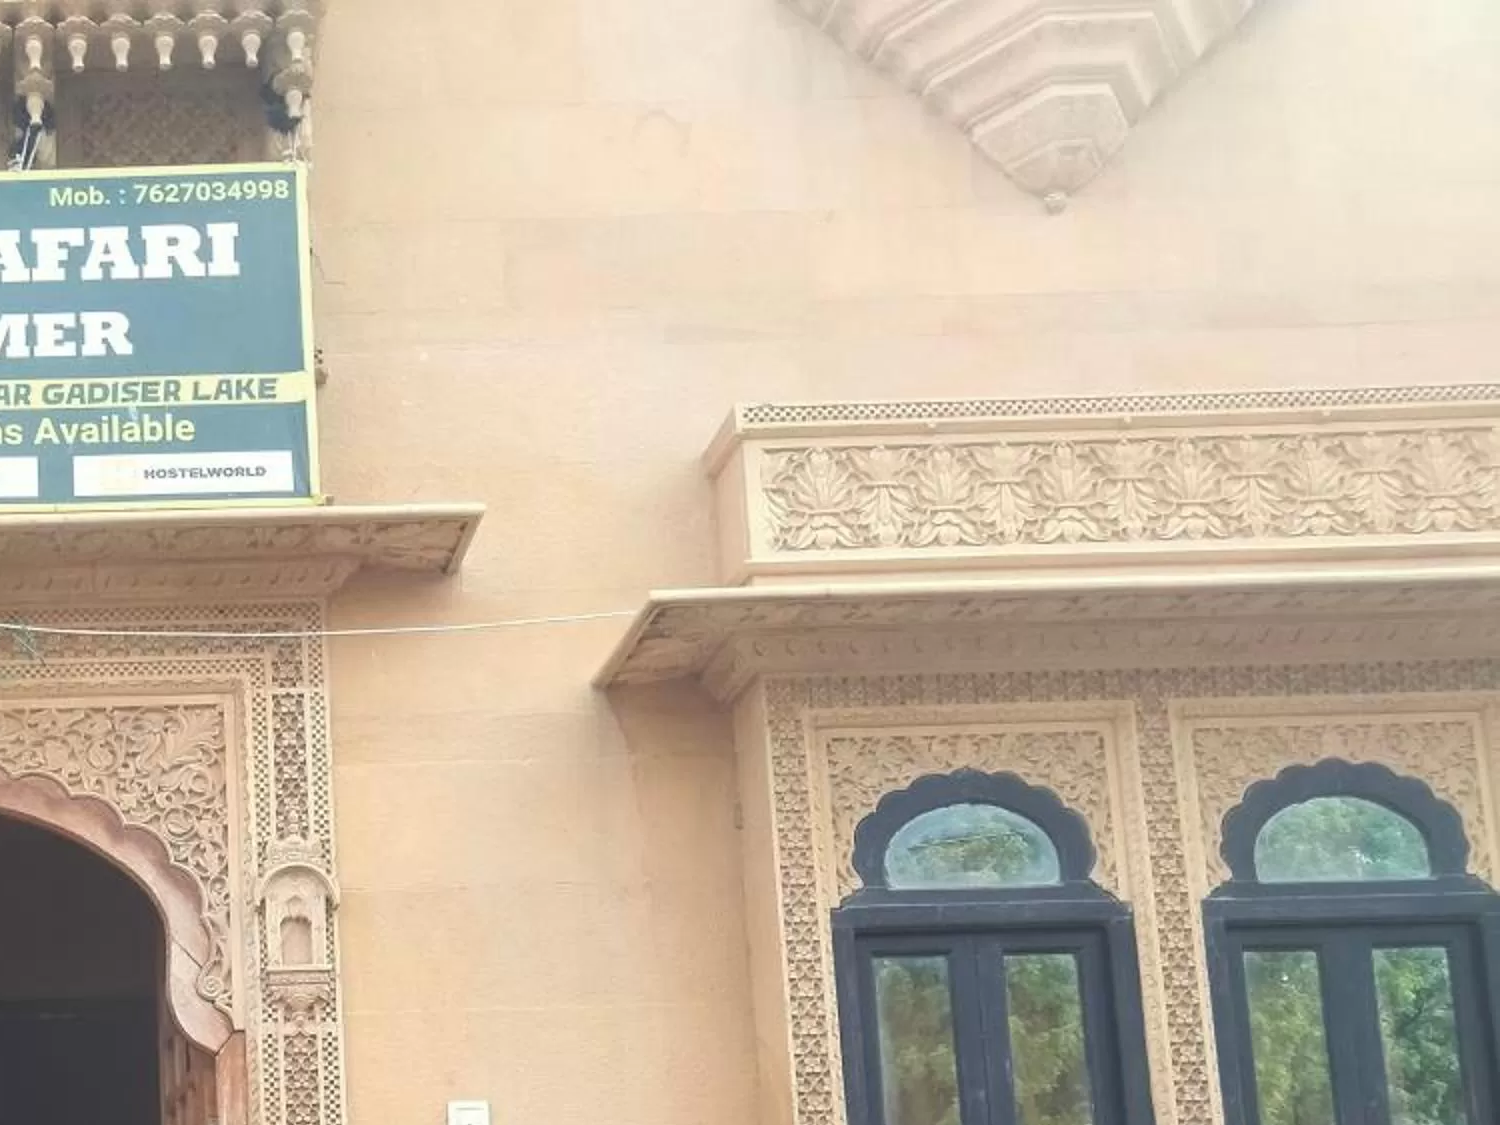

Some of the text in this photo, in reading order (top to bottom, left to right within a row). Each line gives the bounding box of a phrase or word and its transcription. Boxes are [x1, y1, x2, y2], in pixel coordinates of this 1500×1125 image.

[50, 186, 111, 206] Mob.
[133, 180, 289, 205] 7627034998
[42, 379, 182, 406] GADISER
[191, 377, 278, 402] LAKE
[34, 414, 197, 445] Available
[142, 464, 268, 480] HOSTELWORLD
